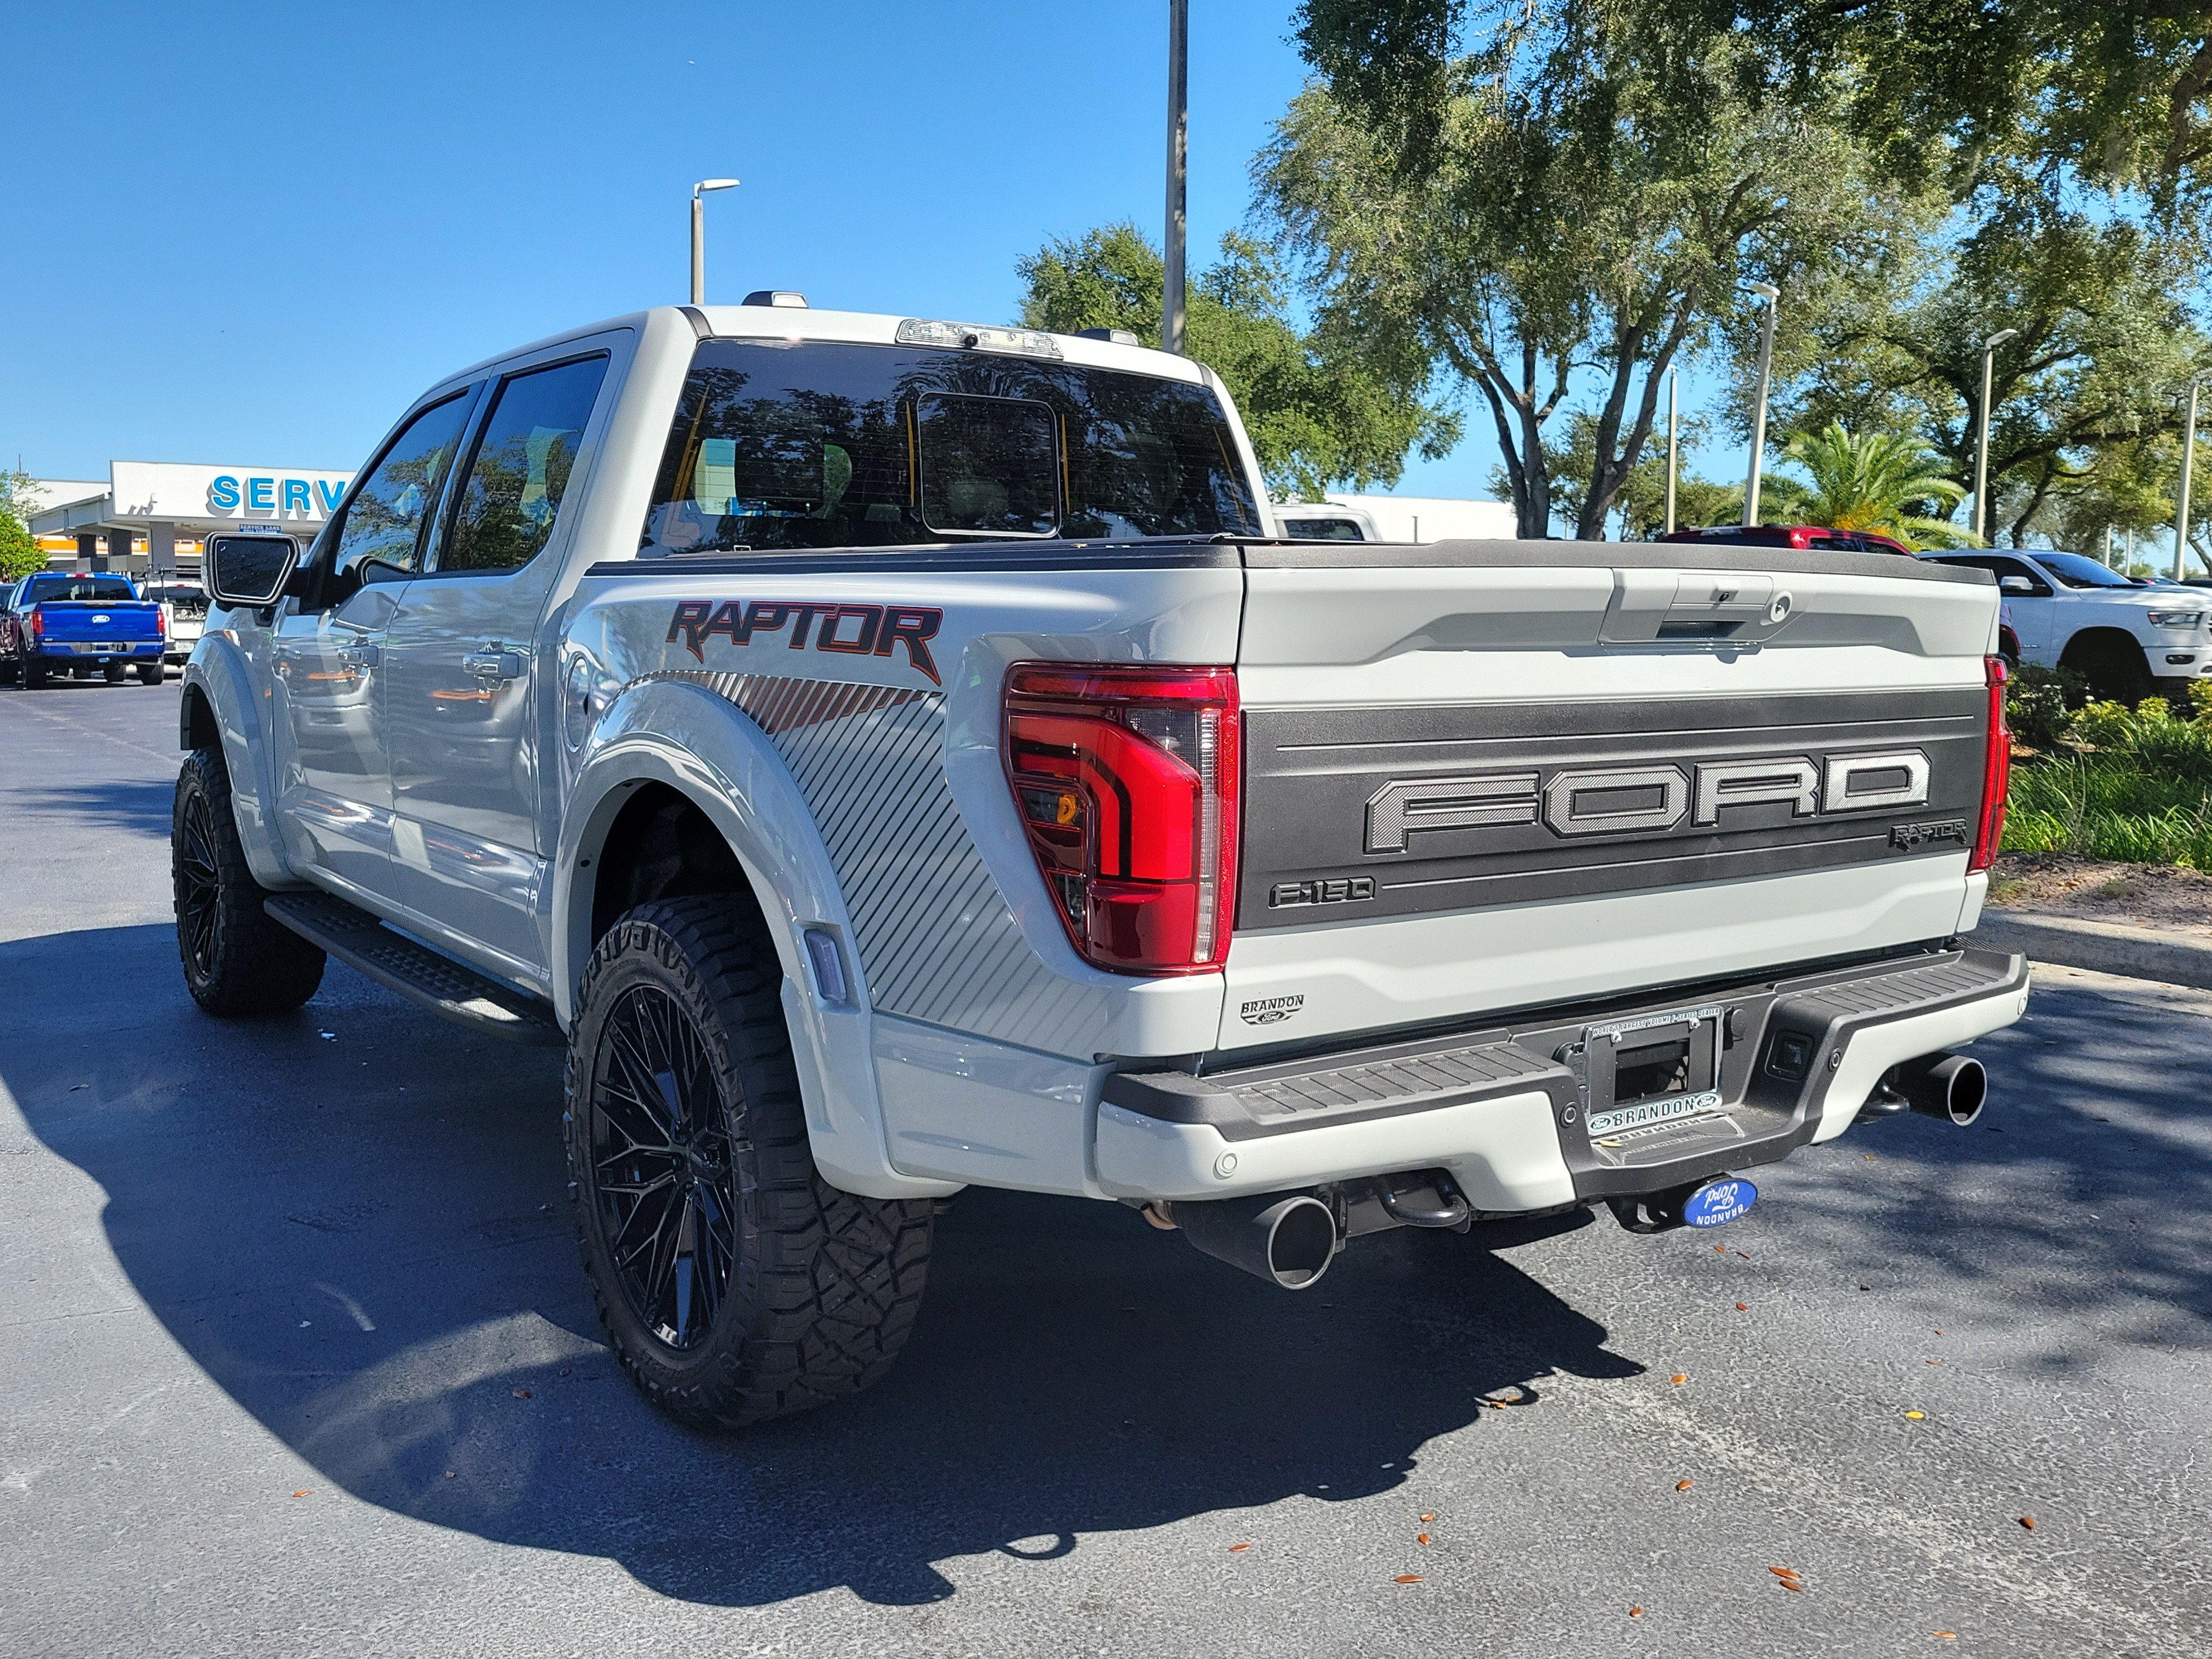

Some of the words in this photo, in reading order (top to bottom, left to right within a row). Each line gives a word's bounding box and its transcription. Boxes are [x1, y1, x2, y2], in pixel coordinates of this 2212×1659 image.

[211, 476, 346, 512] SERV
[666, 600, 943, 686] RAPTOR
[1363, 749, 1932, 854] FORD
[1888, 817, 1968, 852] RAPTOR
[1268, 876, 1376, 909] F-150
[1241, 994, 1304, 1013] BRANDON
[1262, 1012, 1281, 1022] Ford
[1592, 1025, 1618, 1036] WORLD'S
[1620, 1020, 1646, 1031] LARGEST
[1647, 1014, 1671, 1028] VOLUME
[1698, 1007, 1720, 1018] DEALER
[1593, 1119, 1610, 1128] Ford
[1613, 1096, 1695, 1127] BRANDON
[1704, 1183, 1738, 1212] Ford
[1697, 1204, 1743, 1224] BRANDON
